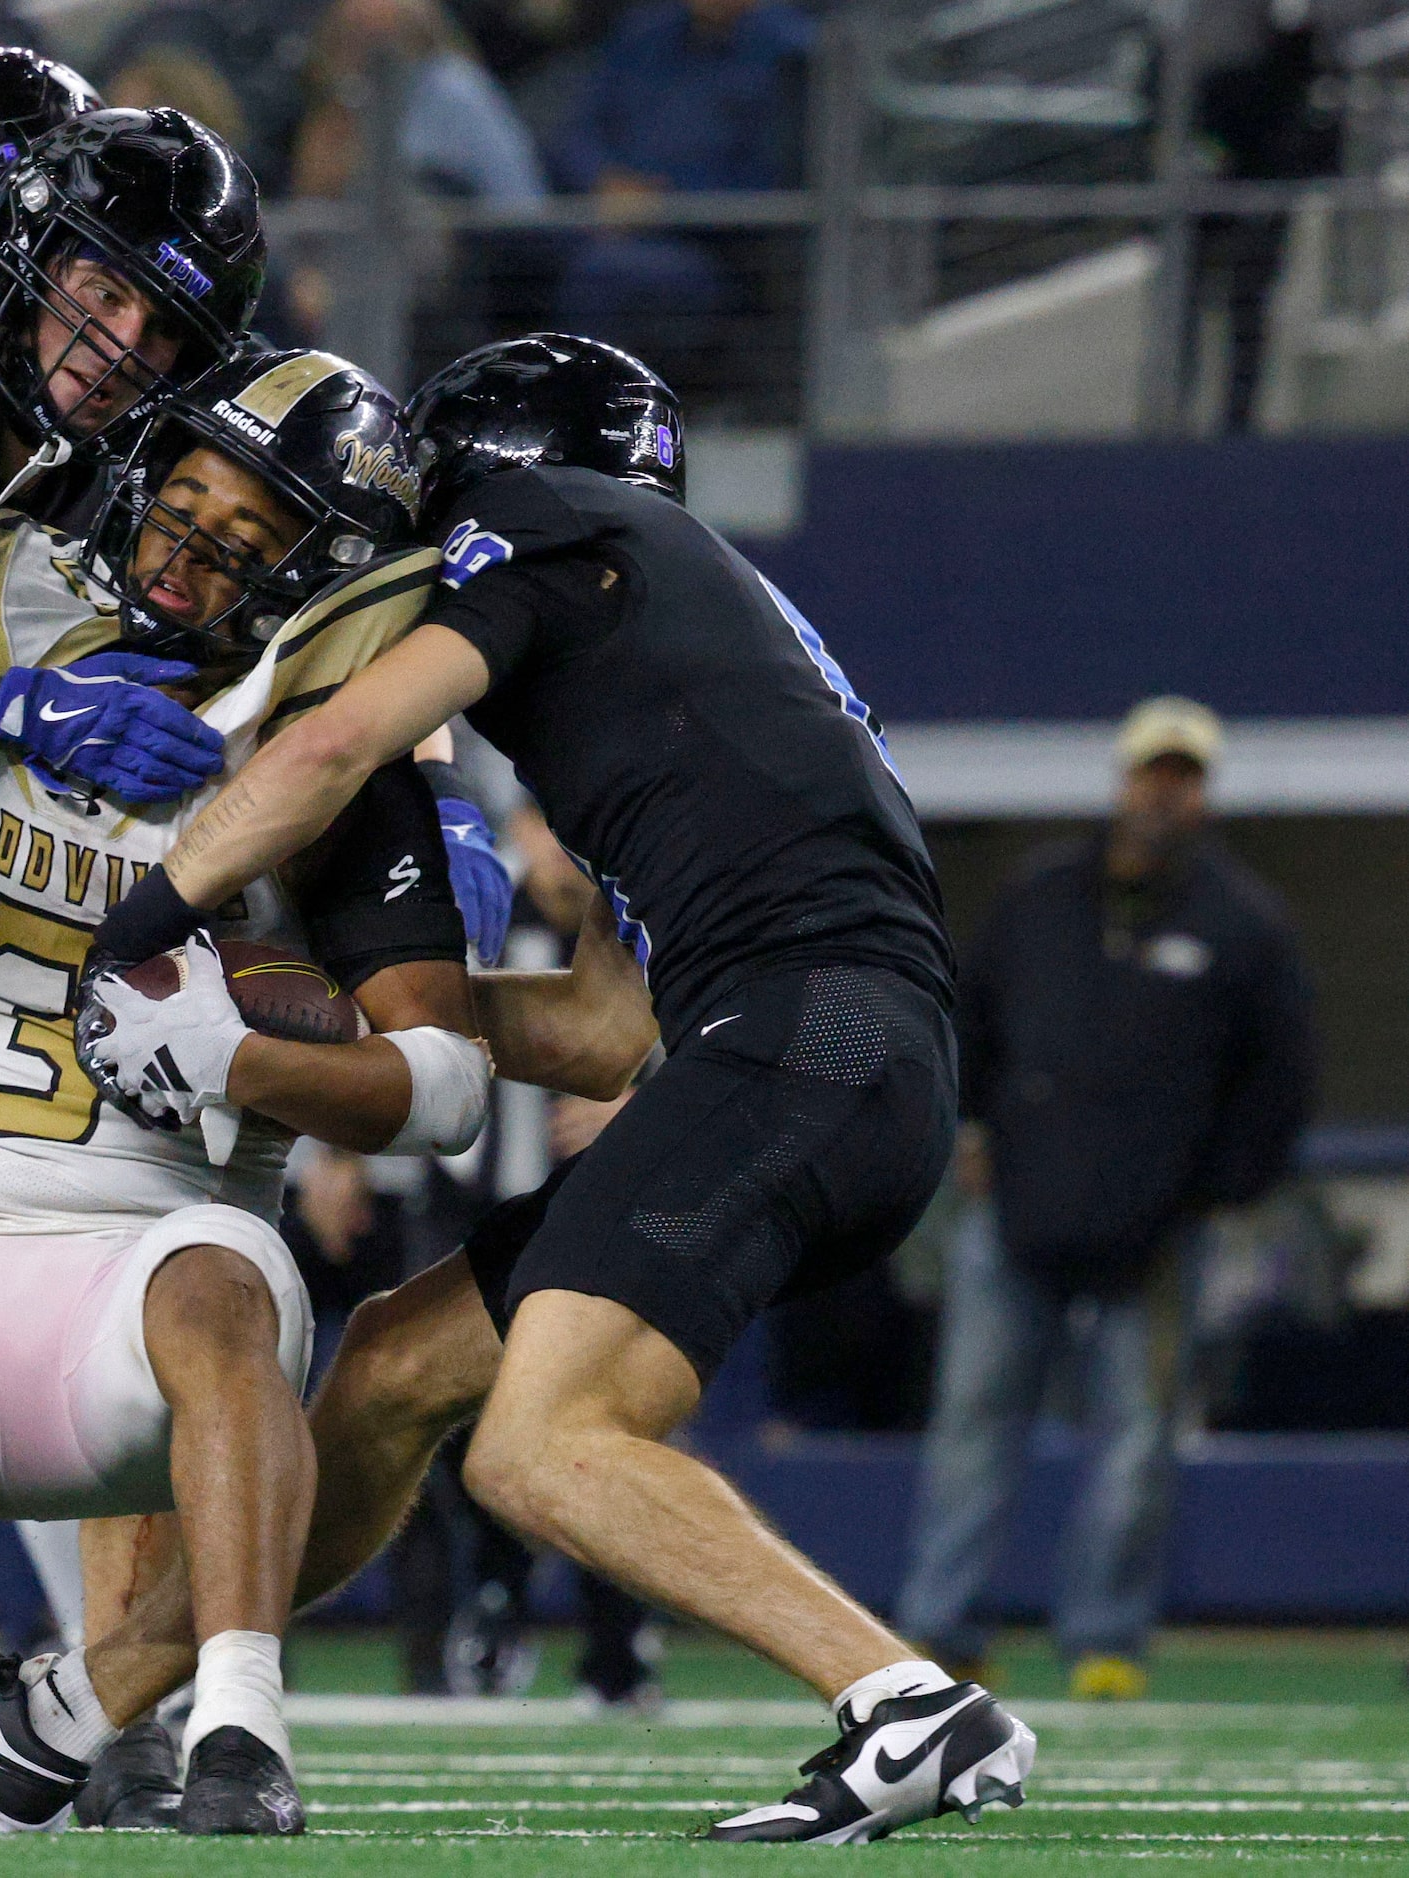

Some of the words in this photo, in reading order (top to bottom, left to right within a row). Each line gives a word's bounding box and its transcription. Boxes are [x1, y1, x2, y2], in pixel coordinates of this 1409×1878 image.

[154, 241, 213, 301] TPW
[211, 399, 277, 446] Riddell
[656, 424, 674, 469] 6
